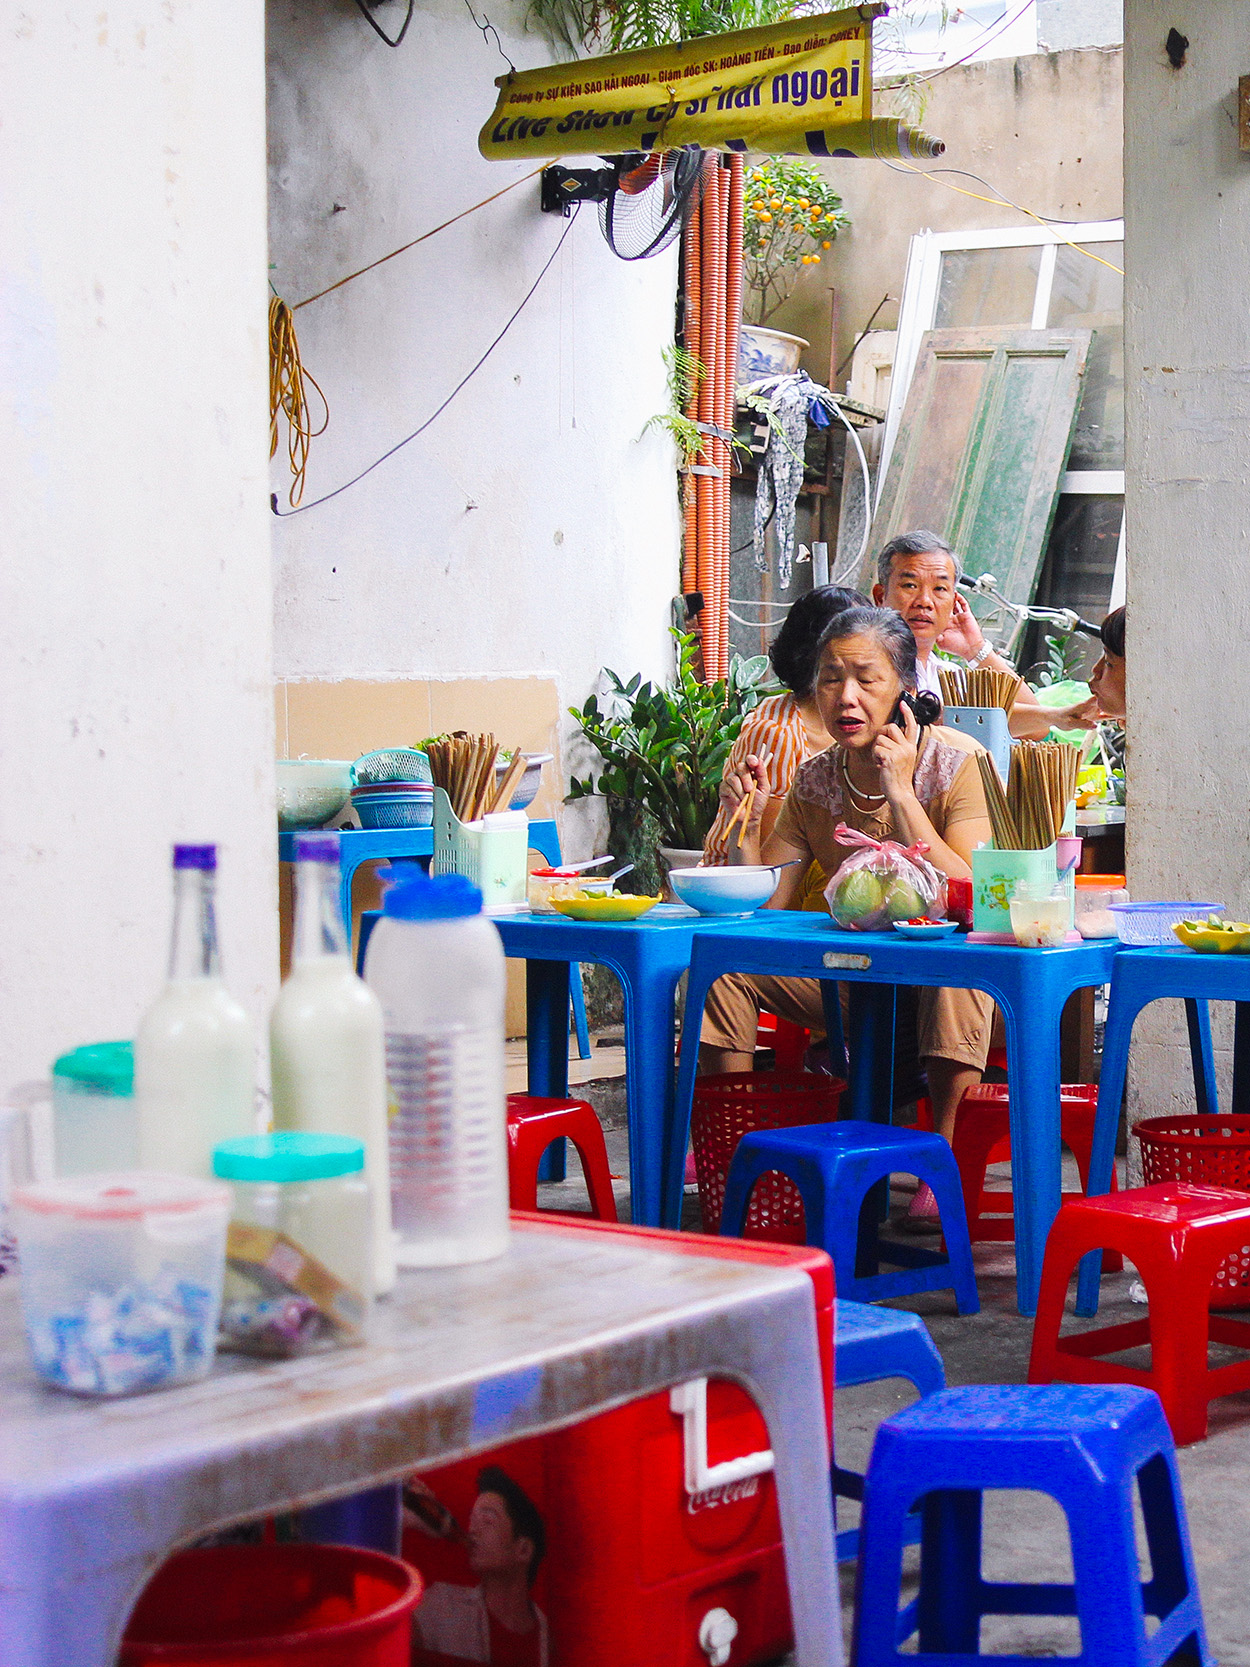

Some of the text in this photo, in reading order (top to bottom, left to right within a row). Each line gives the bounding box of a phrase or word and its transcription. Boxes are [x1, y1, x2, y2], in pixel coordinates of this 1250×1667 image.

[492, 115, 551, 143] Live
[556, 109, 636, 134] Show
[772, 59, 860, 107] ngoại
[509, 93, 533, 104] Công
[535, 91, 545, 103] ty
[561, 82, 582, 100] KIỆN
[584, 82, 602, 95] SAO
[620, 73, 650, 88] NGOẠI
[658, 69, 682, 83] Giám
[684, 62, 700, 78] đốc
[703, 60, 718, 74] SK:
[720, 51, 752, 70] HOÀNG
